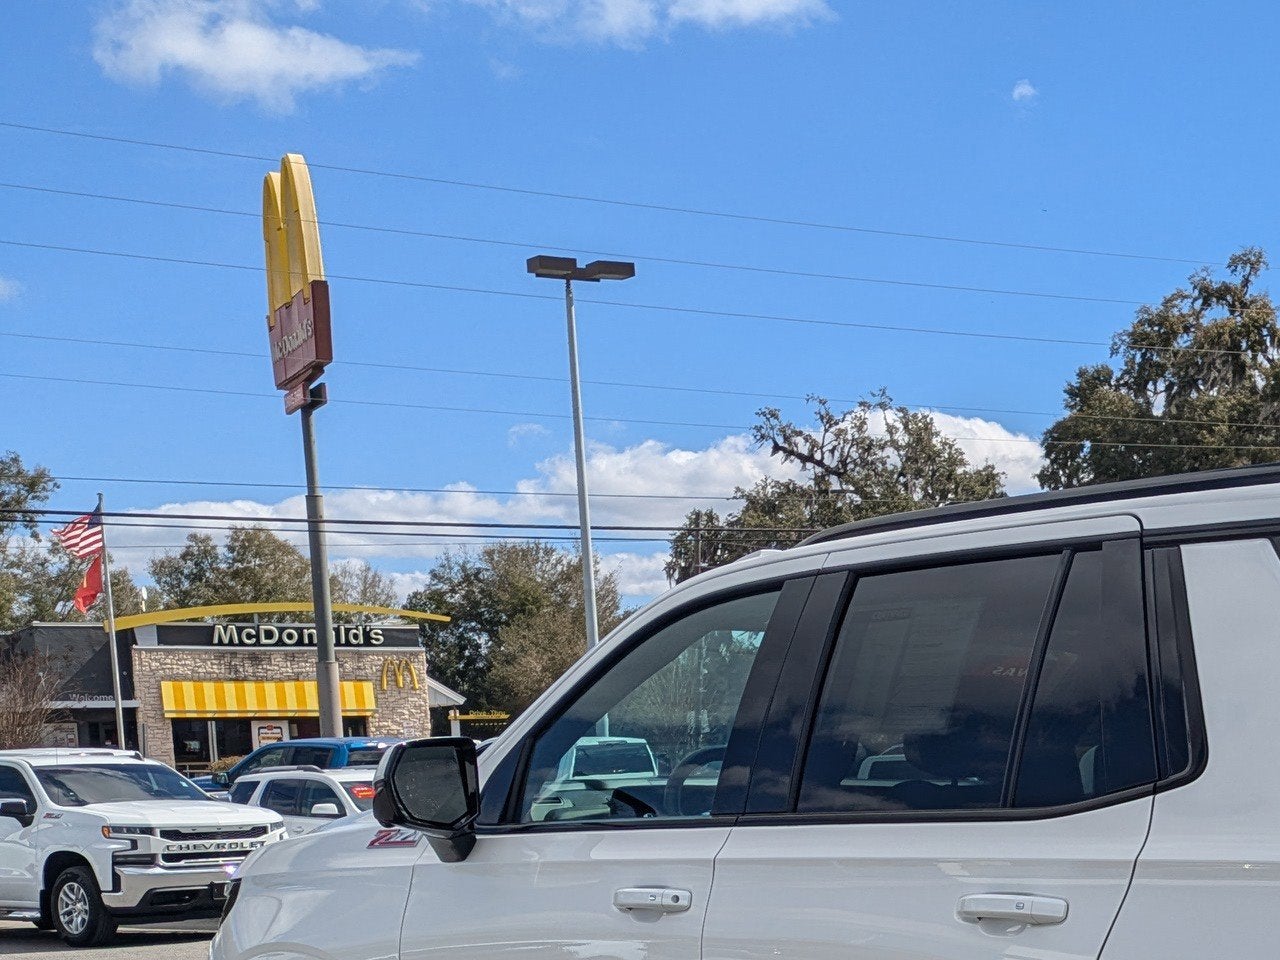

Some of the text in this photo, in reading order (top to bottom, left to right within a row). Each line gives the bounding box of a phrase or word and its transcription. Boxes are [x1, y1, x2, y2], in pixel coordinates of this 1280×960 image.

[212, 624, 385, 645] McDonld's
[69, 691, 114, 701] Welcome
[166, 841, 267, 852] CHEVROLET
